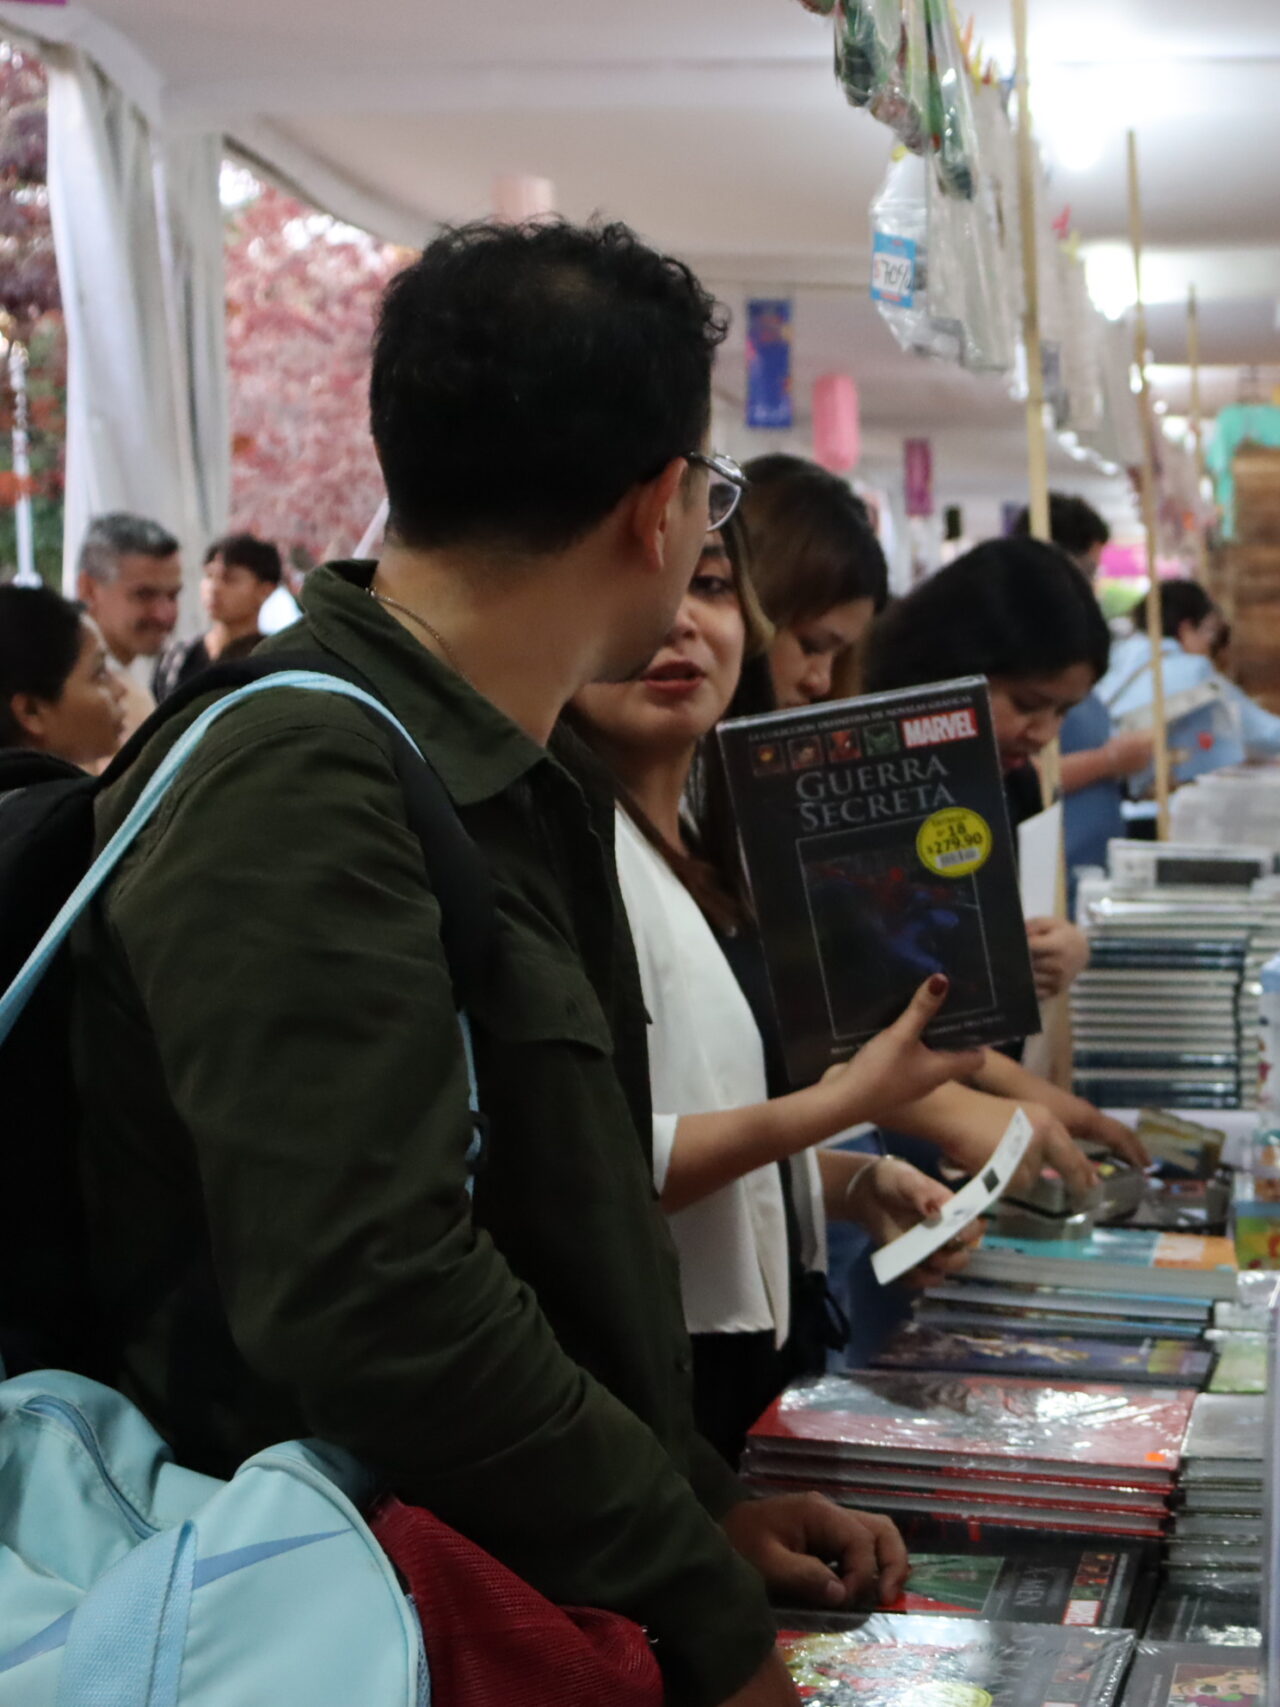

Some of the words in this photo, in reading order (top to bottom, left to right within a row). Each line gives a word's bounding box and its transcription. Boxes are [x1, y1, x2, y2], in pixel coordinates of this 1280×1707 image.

[904, 710, 977, 748] MARVEL
[796, 754, 949, 801] GUERRA
[800, 783, 957, 832] SECRETA
